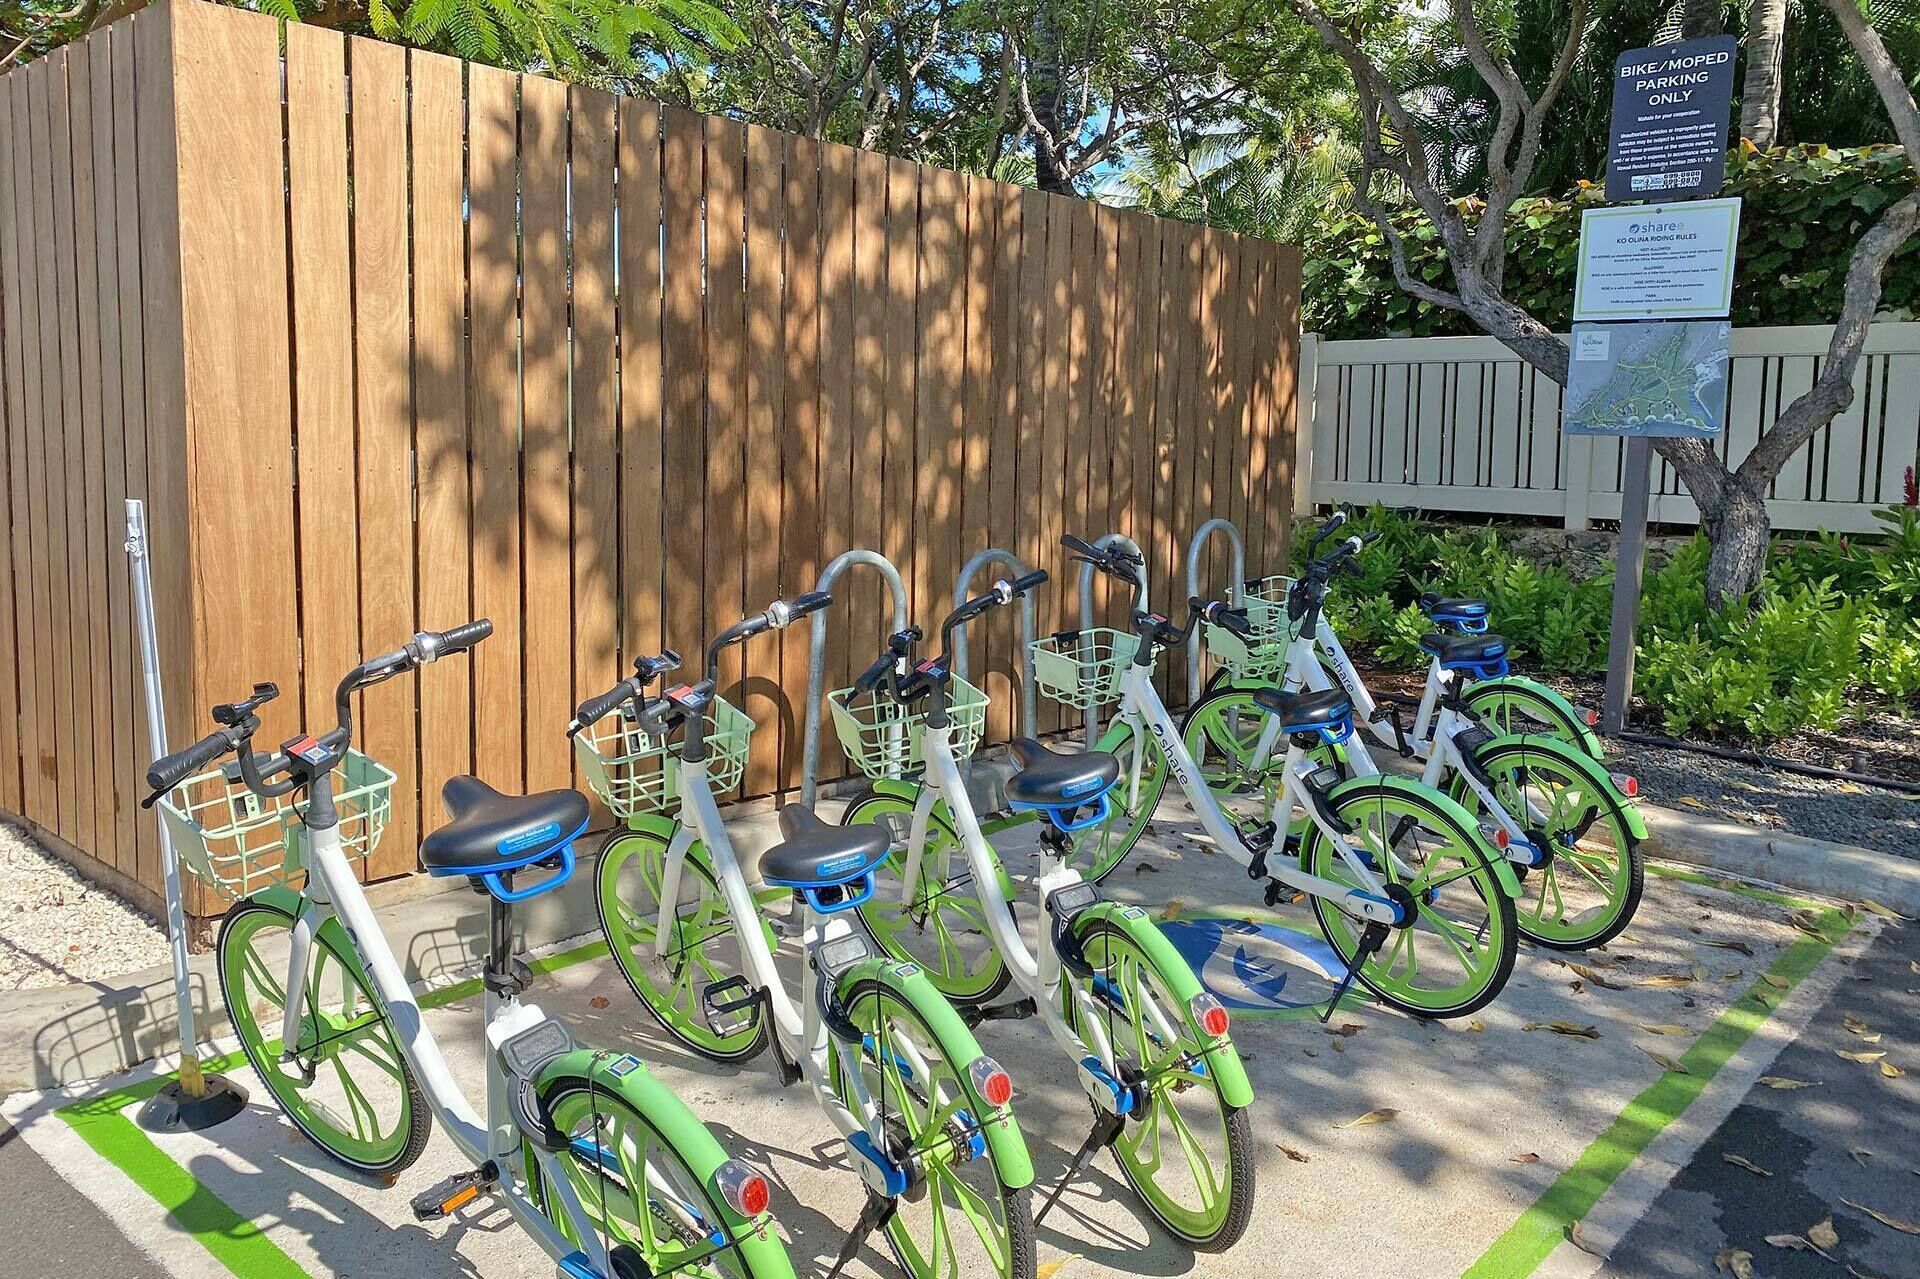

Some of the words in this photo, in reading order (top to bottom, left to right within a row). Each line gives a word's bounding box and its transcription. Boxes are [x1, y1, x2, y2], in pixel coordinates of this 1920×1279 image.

[1620, 52, 1729, 77] BIKE/MOPED
[1636, 71, 1710, 91] PARKING
[1648, 90, 1693, 106] ONLY
[1628, 236, 1649, 244] OLINA
[1650, 234, 1675, 242] RIDING
[1676, 233, 1697, 241] RULES
